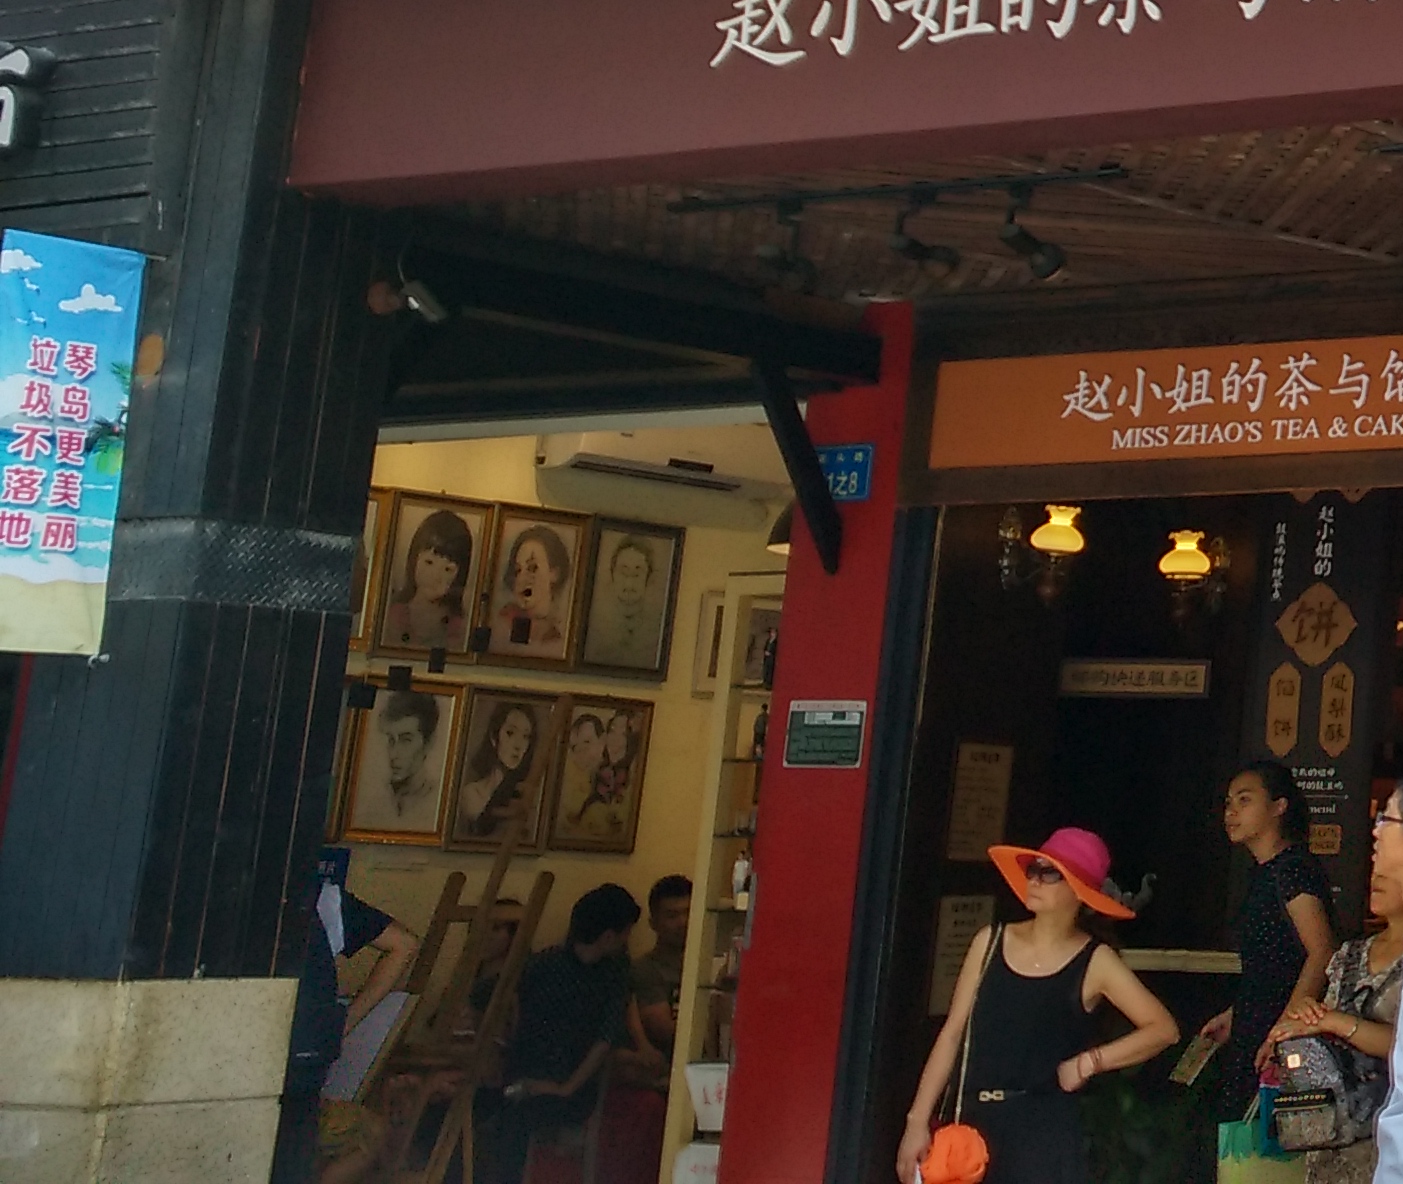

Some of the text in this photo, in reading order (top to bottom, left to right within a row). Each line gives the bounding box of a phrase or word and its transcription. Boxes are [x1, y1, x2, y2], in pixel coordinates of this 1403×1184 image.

[0, 335, 58, 548] 垃圾不落地
[40, 342, 97, 551] 琴岛更美丽
[1111, 427, 1169, 449] MISS
[1271, 418, 1320, 440] TEA
[1328, 417, 1349, 438] &
[823, 471, 859, 495] 1之8
[1313, 504, 1336, 578] 赵小姐的
[1291, 601, 1340, 647] 饼
